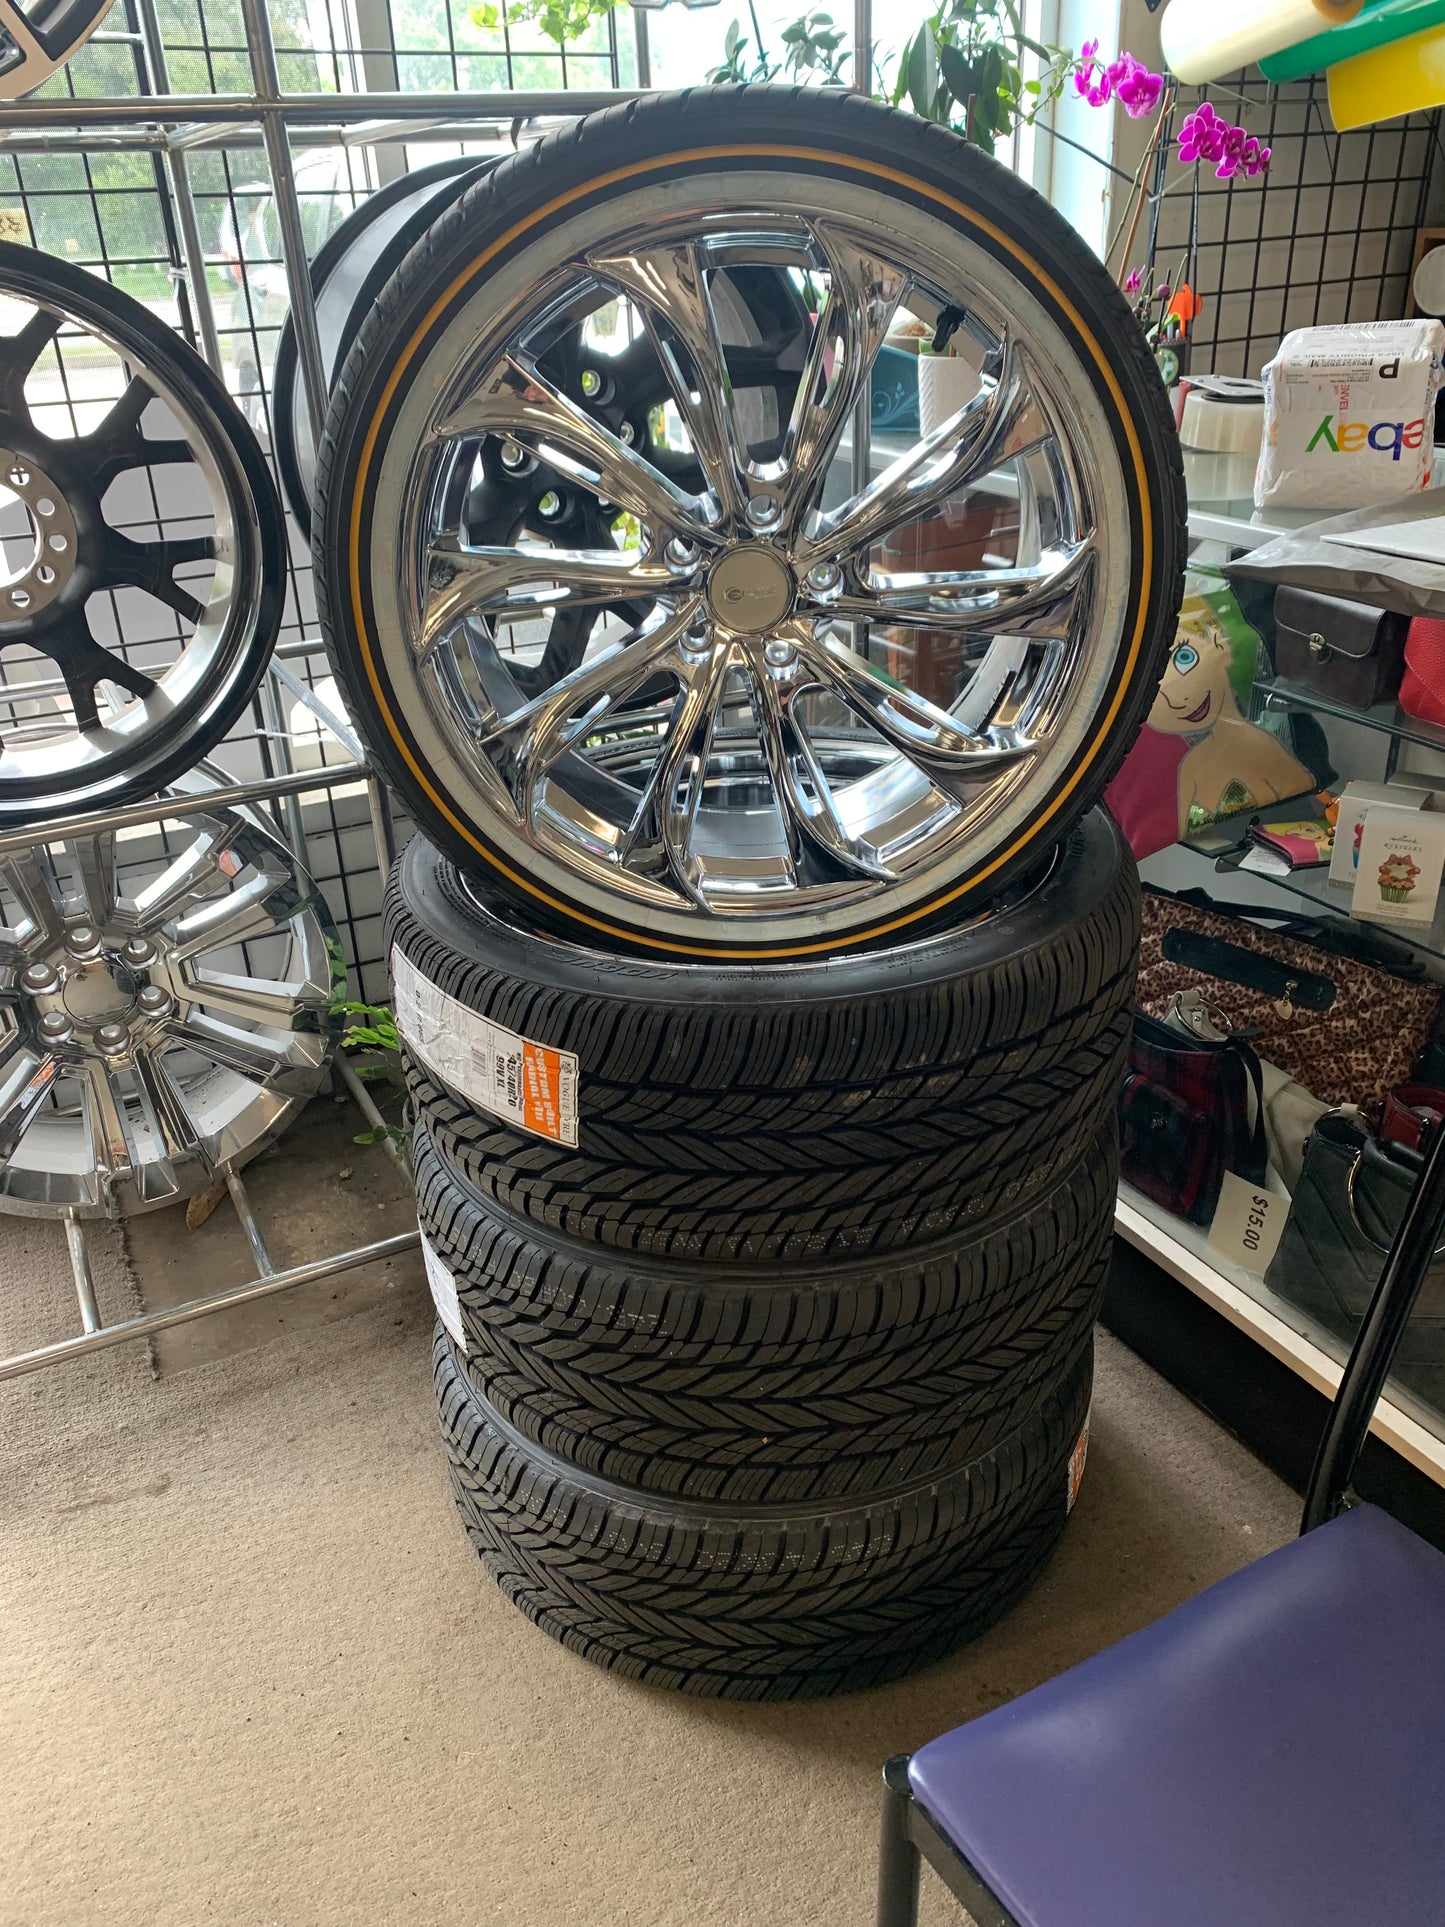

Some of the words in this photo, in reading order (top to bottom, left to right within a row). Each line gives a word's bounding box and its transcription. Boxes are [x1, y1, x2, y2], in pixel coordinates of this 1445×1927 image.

[1378, 358, 1400, 379] P
[1305, 414, 1425, 461] ebay
[496, 1055, 505, 1079] 99V
[497, 1079, 505, 1088] XL
[525, 1057, 540, 1098] RADIAL
[535, 1048, 551, 1099] CUSTOM
[544, 1101, 557, 1136] BUILT
[562, 1077, 570, 1111] VOGUE
[1242, 1195, 1269, 1250] $15.00
